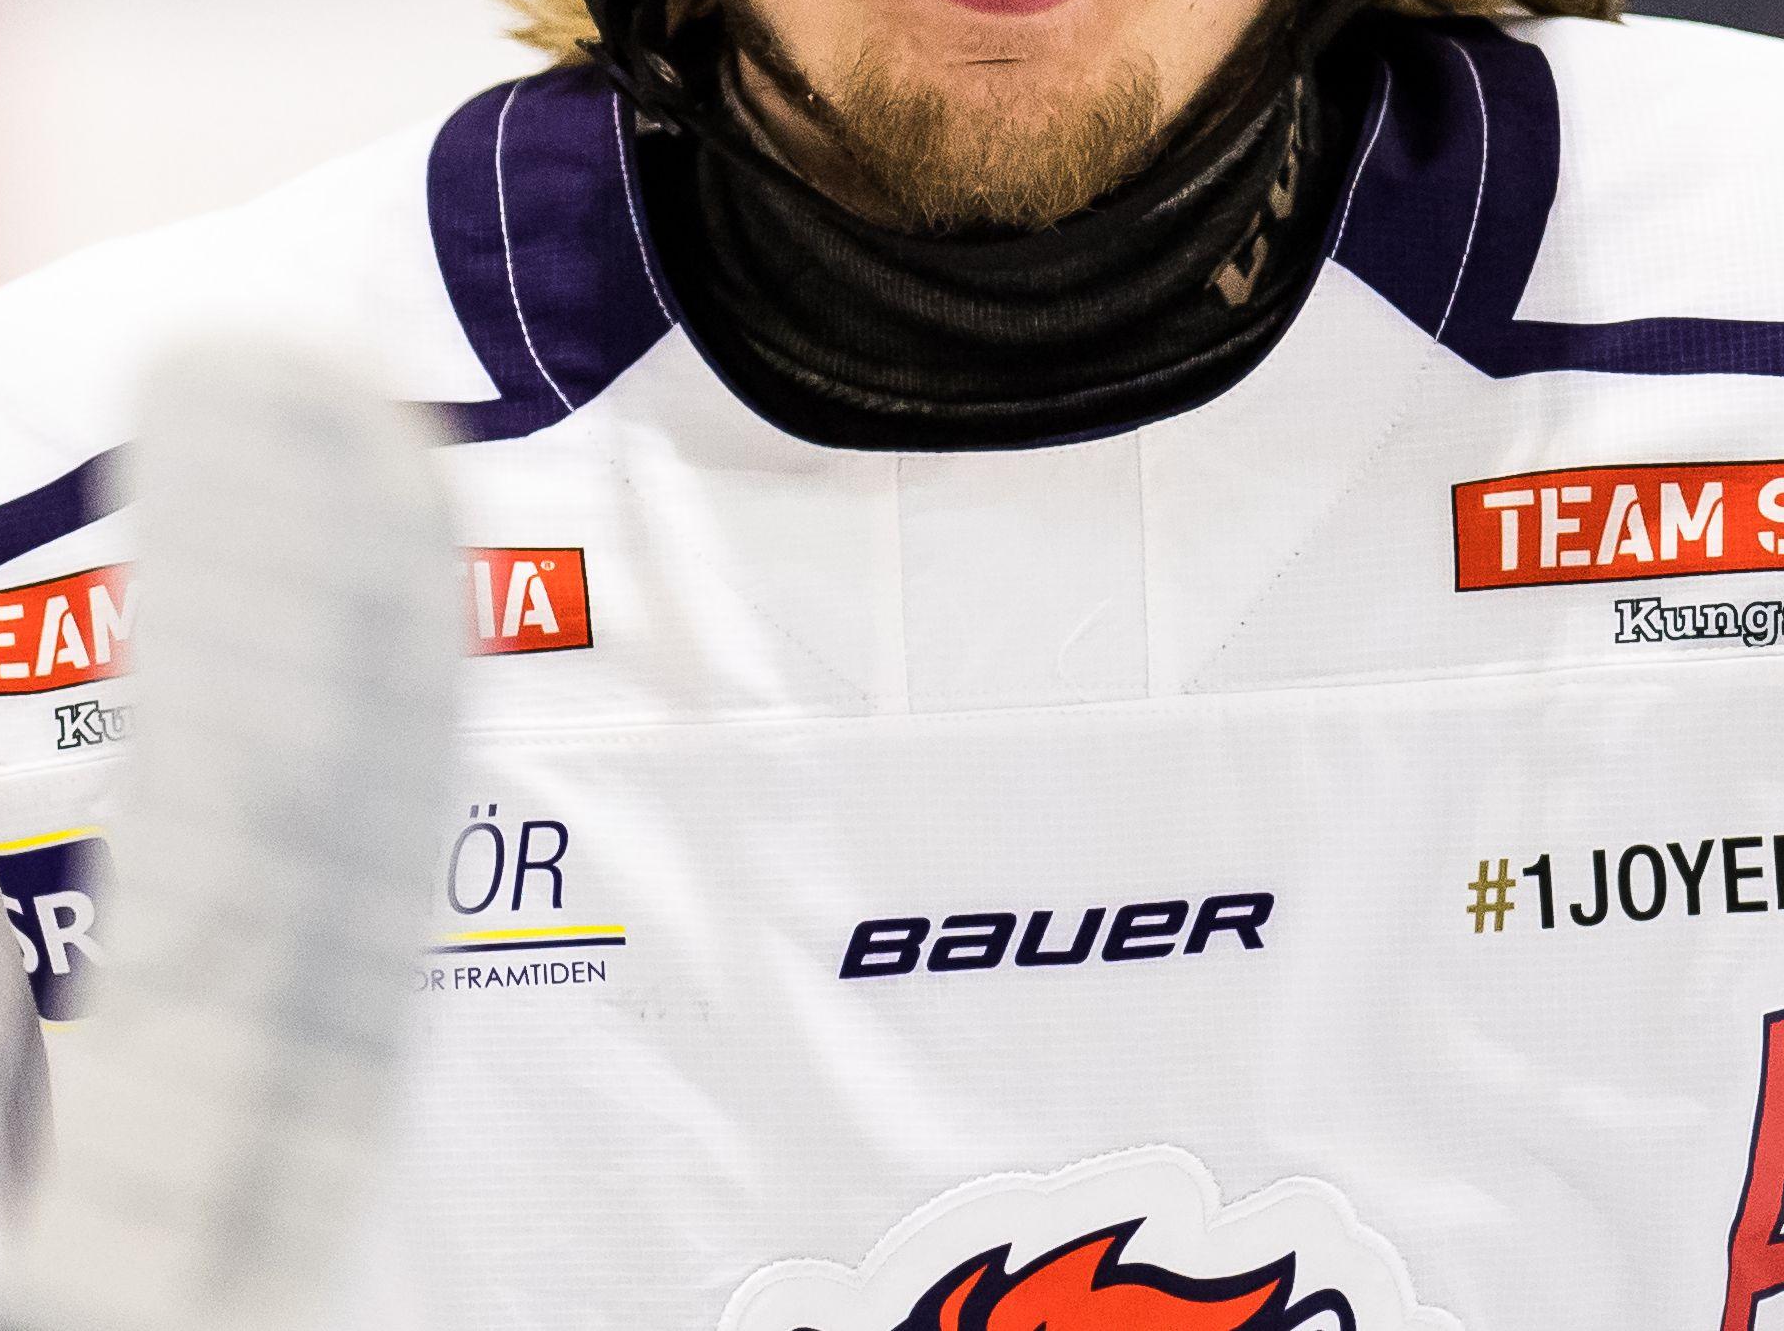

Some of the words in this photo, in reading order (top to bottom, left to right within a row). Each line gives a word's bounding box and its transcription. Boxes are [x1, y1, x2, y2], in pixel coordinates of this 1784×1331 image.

[1482, 479, 1724, 572] TEAM
[454, 960, 607, 990] FRAMTIDEN
[839, 892, 1275, 980] BAUER
